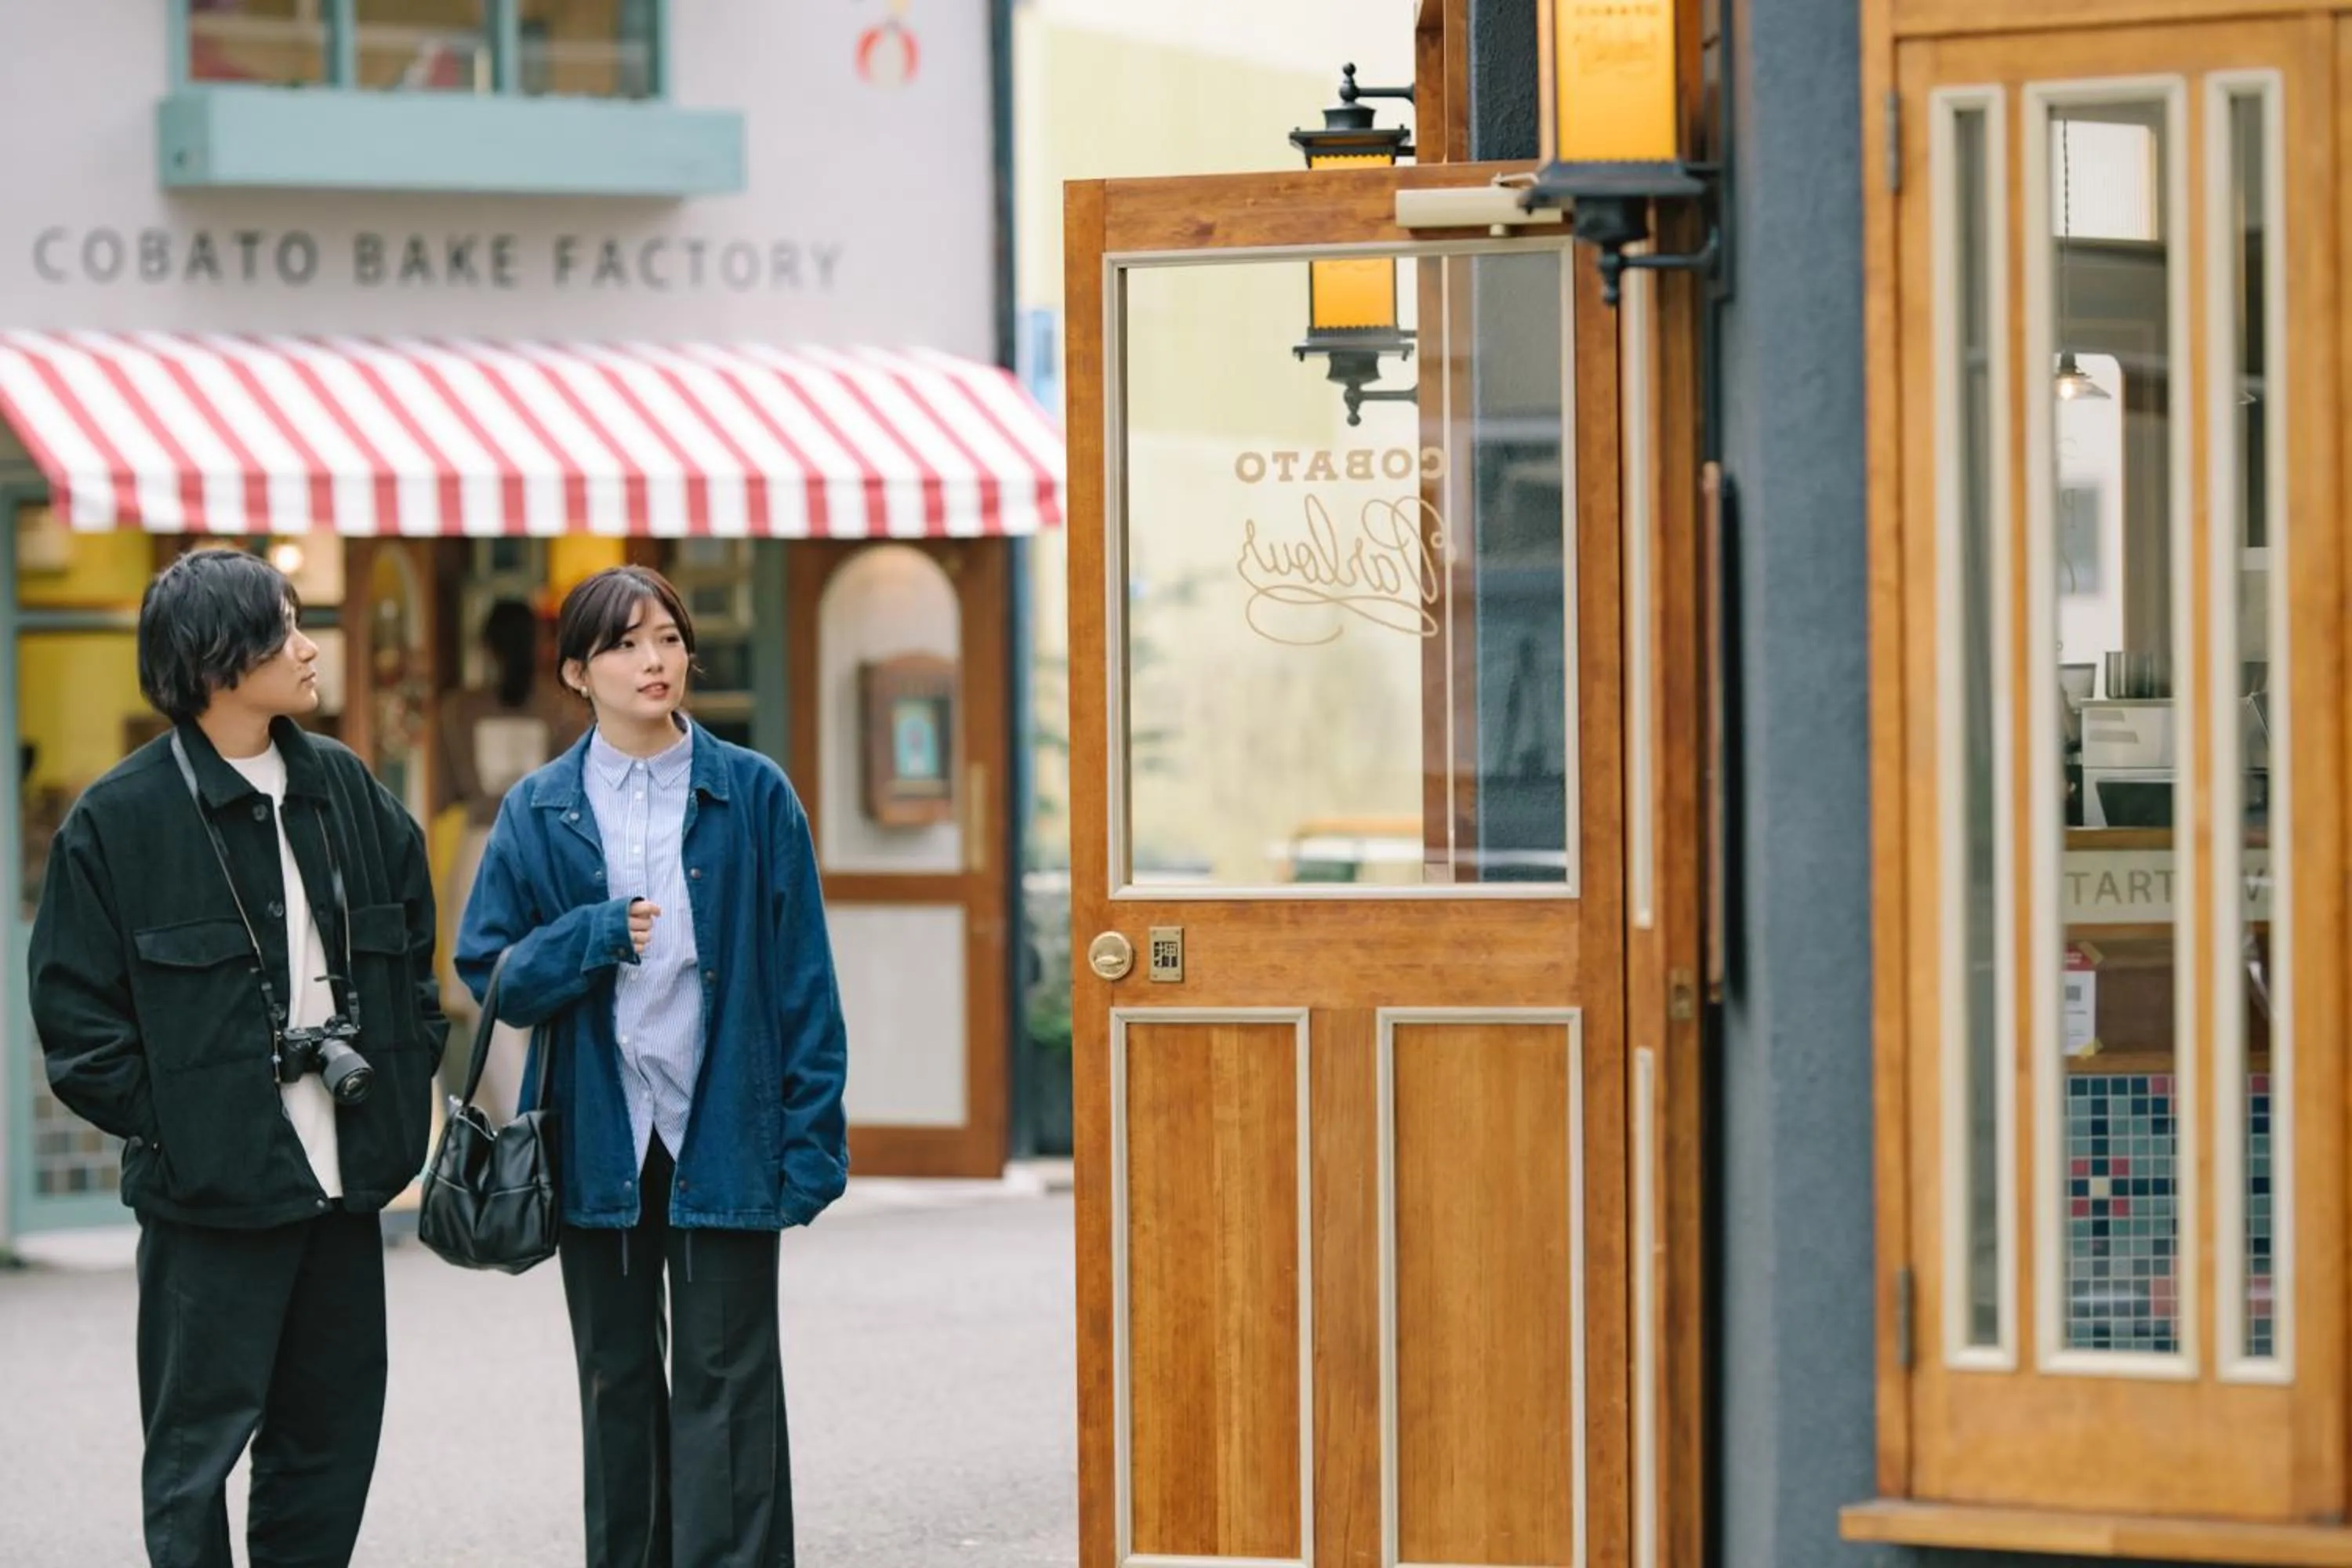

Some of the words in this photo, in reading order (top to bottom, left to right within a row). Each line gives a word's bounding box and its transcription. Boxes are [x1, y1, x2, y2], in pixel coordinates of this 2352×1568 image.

[33, 226, 318, 288] COBATO
[352, 230, 519, 289] BAKE
[554, 235, 844, 293] FACTORY
